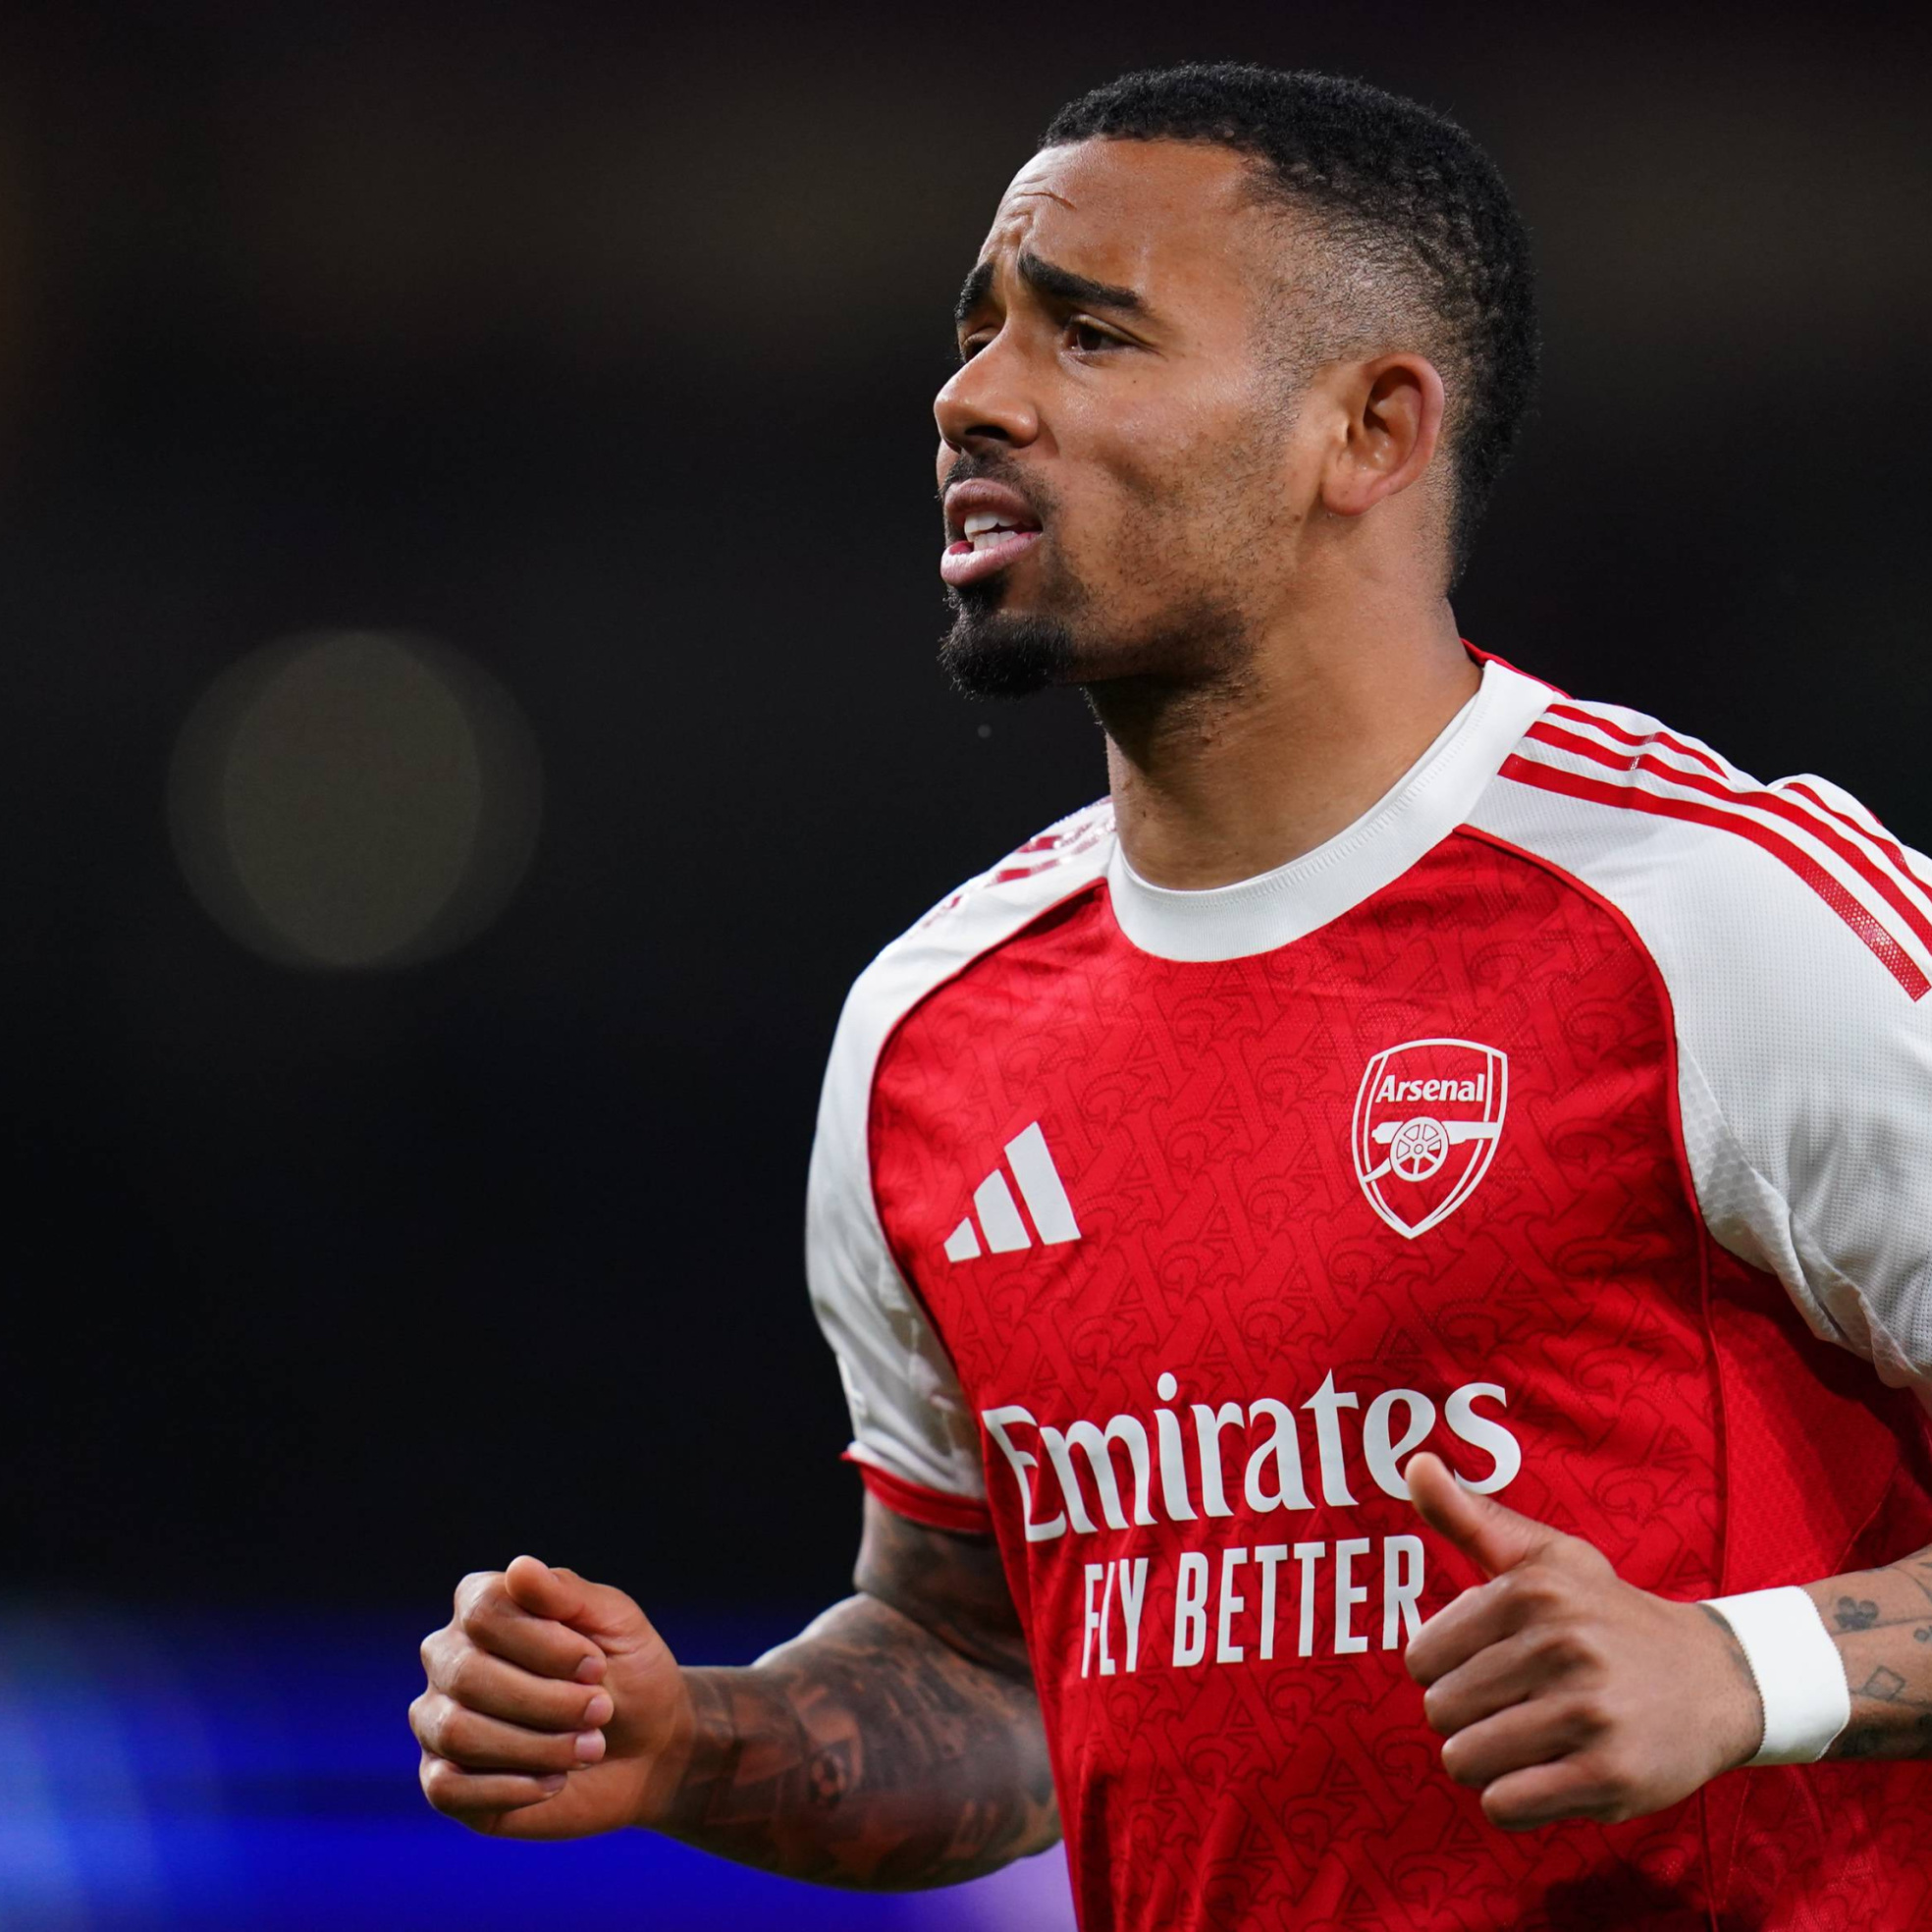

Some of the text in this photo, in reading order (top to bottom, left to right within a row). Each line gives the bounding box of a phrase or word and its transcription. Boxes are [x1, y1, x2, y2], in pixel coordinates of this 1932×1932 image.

[1375, 1073, 1484, 1102] Arsenal
[982, 1368, 1522, 1542] Emirates
[1081, 1534, 1424, 1678] FLY BETTER
